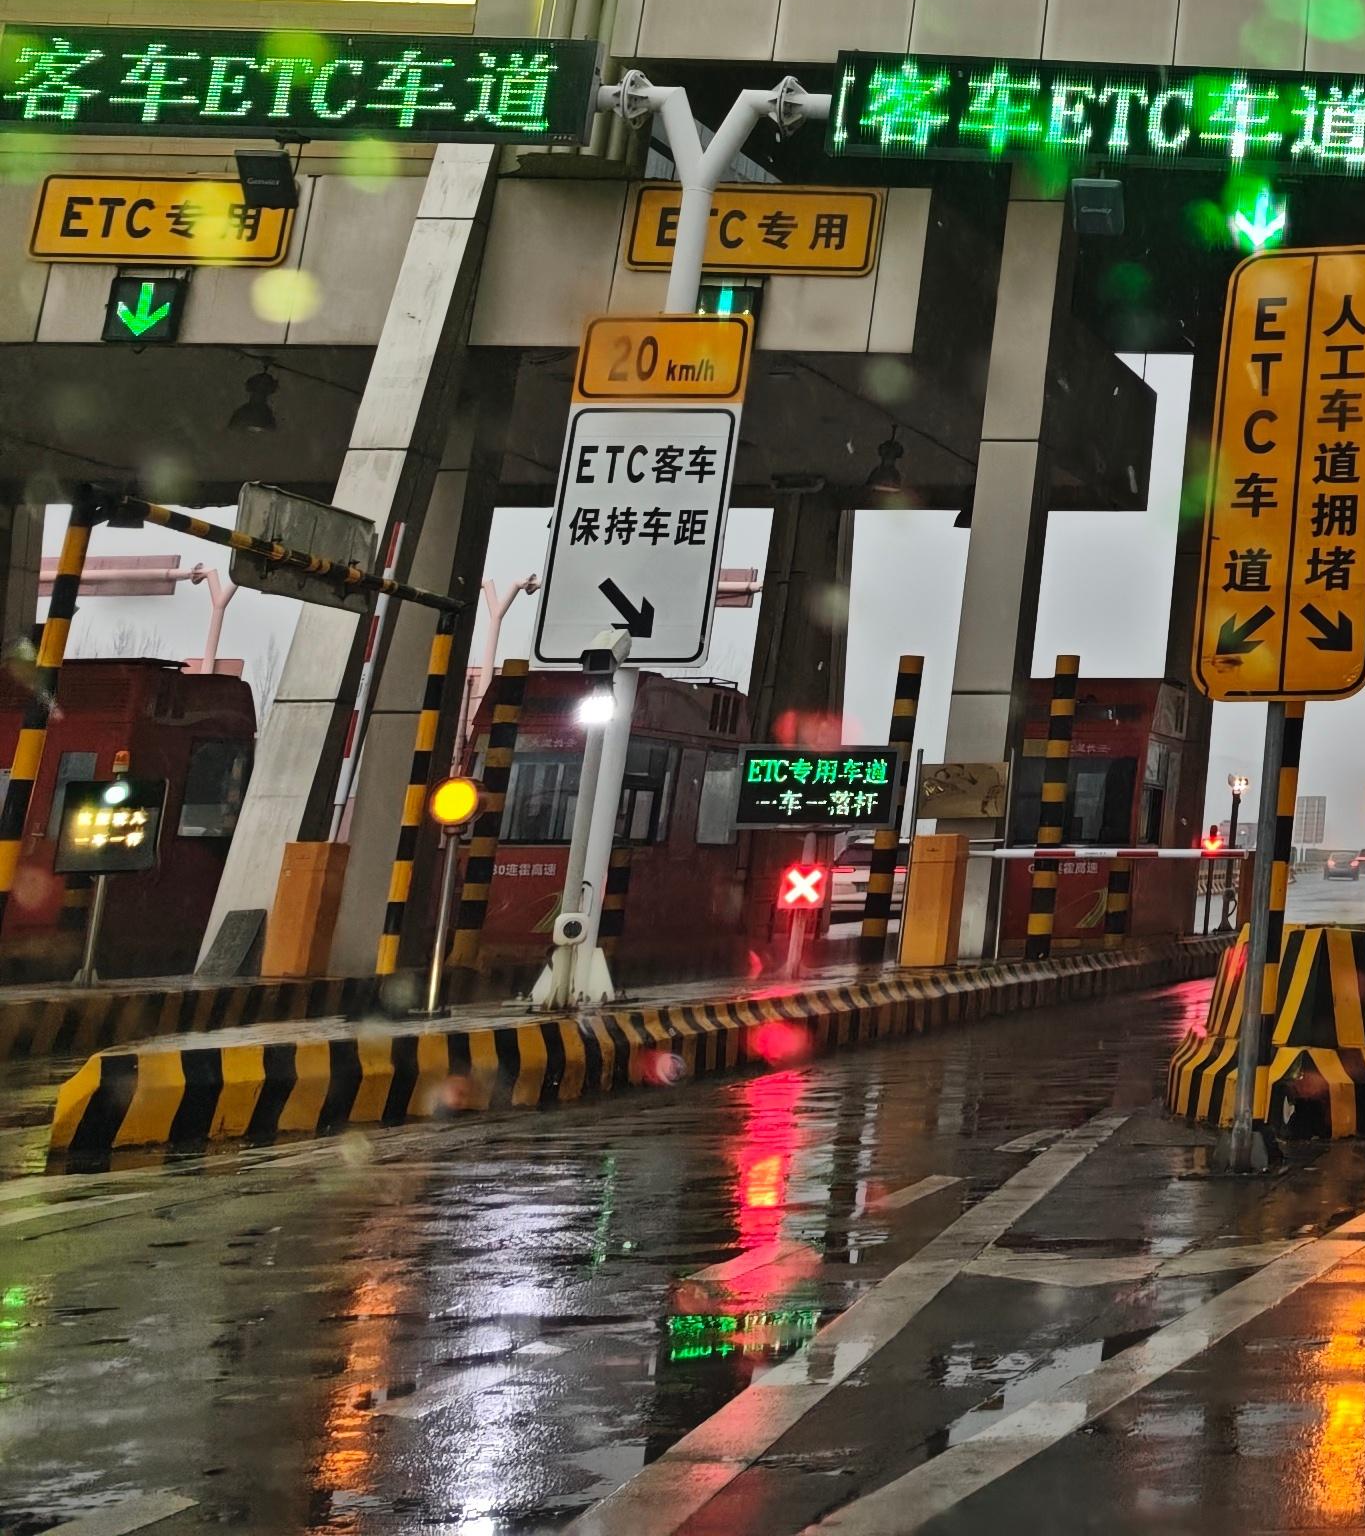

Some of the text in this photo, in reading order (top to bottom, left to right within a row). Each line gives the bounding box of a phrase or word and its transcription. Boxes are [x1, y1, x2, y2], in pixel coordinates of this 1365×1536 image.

[3, 37, 559, 131] 客车ETC车道
[655, 209, 849, 252] EC专用
[606, 334, 715, 383] 20 km/h
[575, 444, 718, 484] ETC客车
[1222, 296, 1288, 593] ETC车道
[569, 505, 708, 546] 保持车距
[747, 758, 889, 785] ETC专用车道
